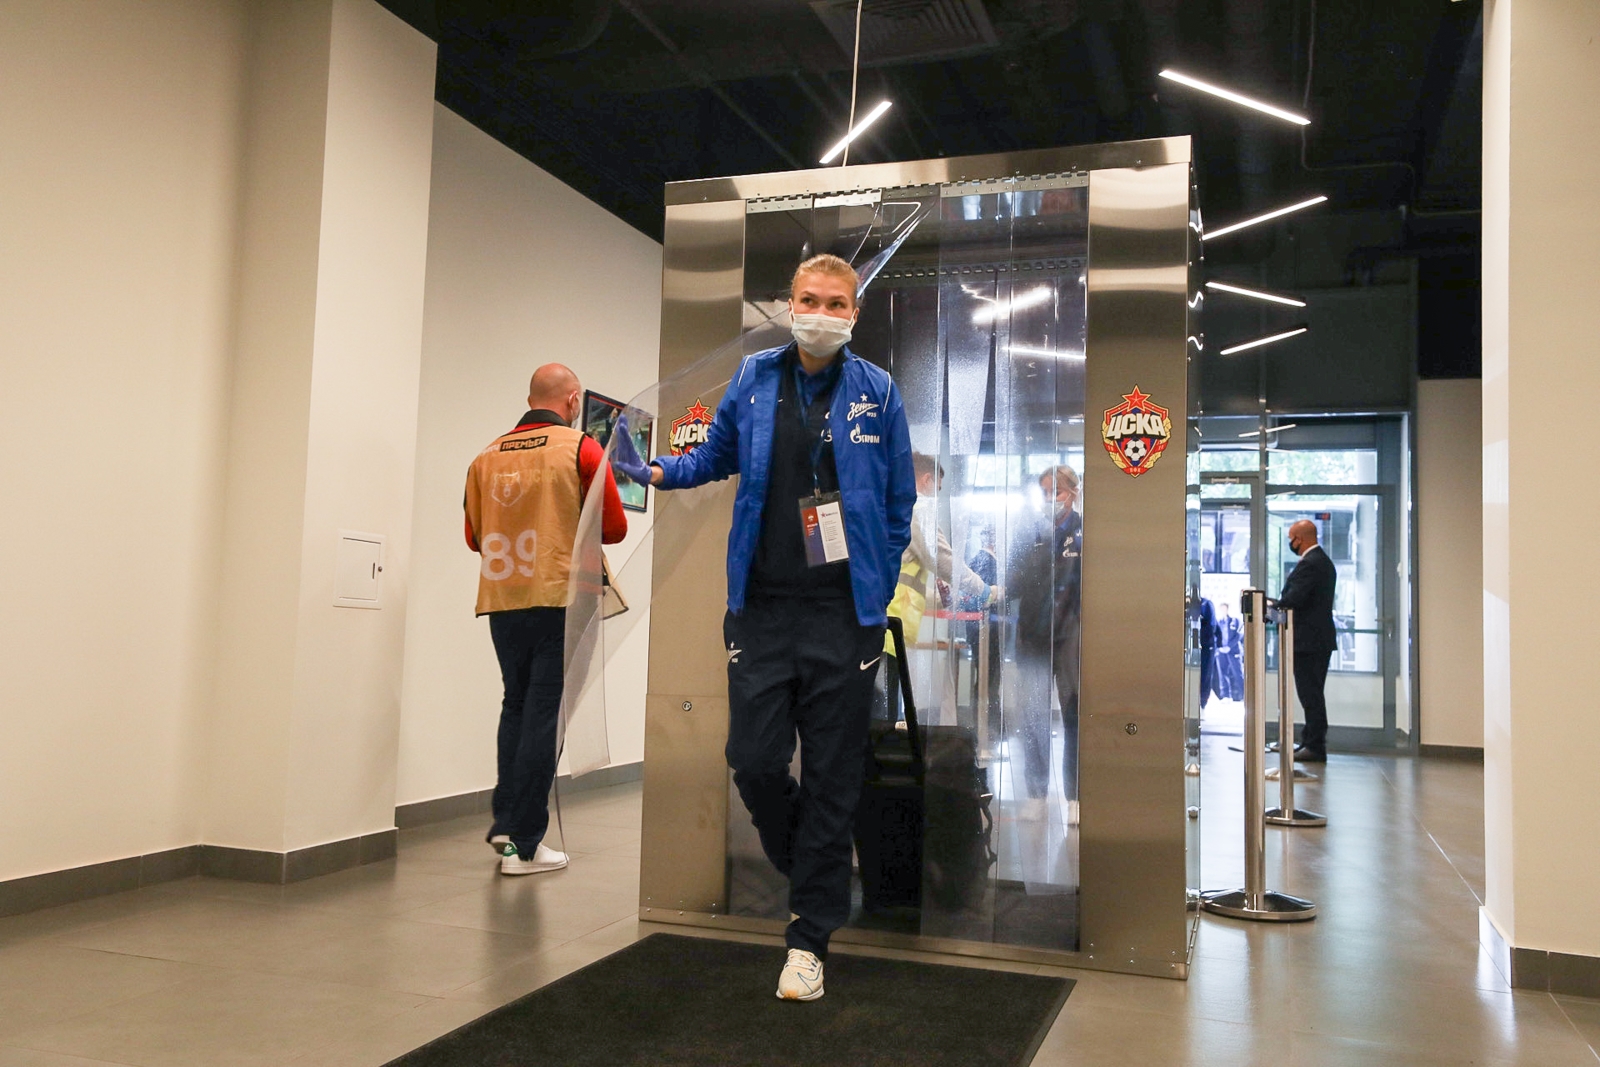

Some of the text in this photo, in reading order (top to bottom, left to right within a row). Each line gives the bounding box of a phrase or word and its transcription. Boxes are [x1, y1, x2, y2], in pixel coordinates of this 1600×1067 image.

[673, 423, 710, 447] ЦСК
[1106, 413, 1167, 439] ЦСКА
[502, 437, 546, 450] ПРЕМЬЕР
[481, 529, 536, 581] 89
